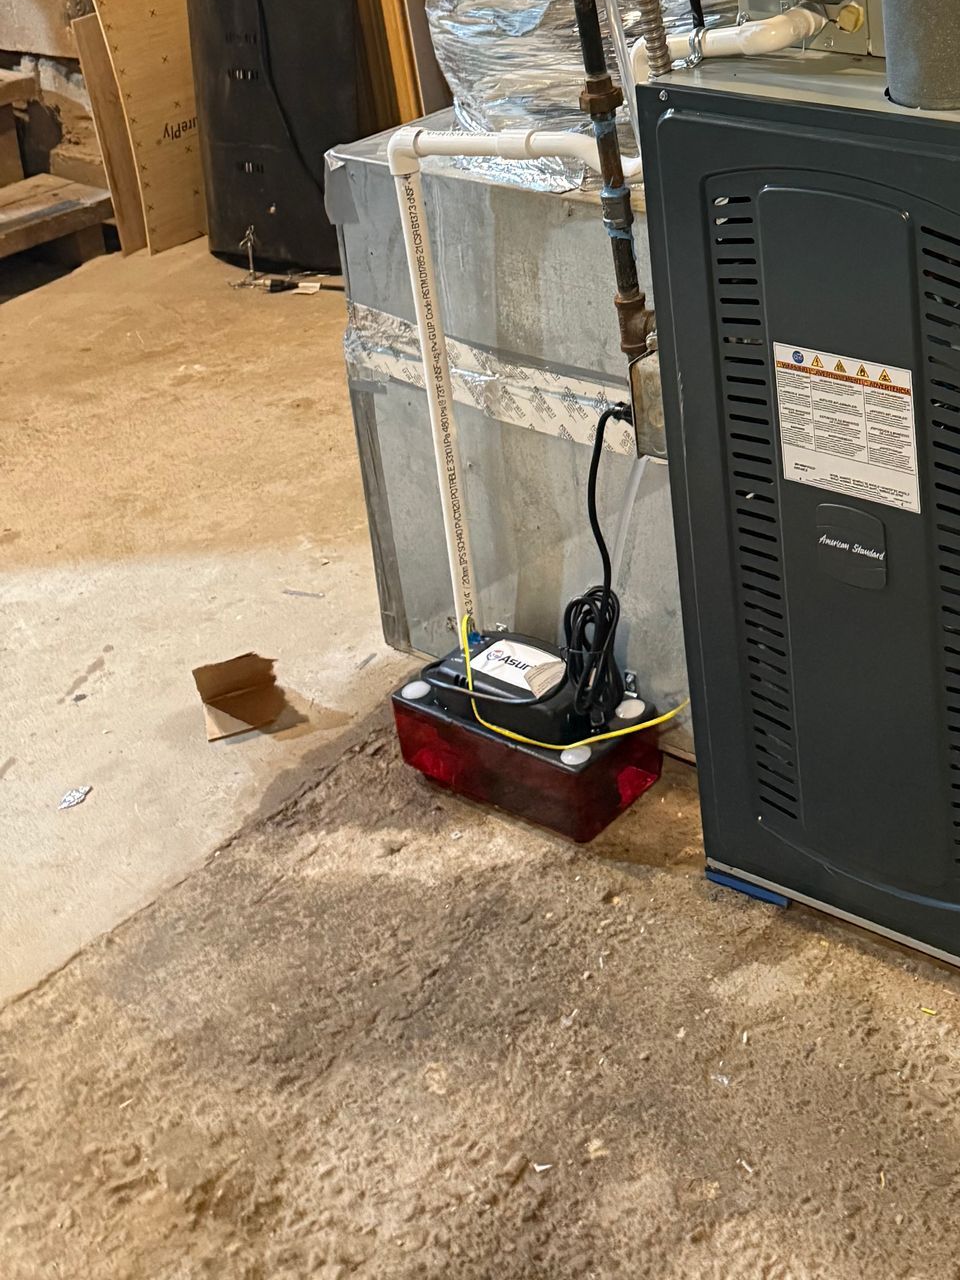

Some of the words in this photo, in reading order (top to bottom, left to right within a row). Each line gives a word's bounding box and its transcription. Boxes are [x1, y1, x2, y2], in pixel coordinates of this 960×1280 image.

[440, 416, 450, 432] 480
[818, 533, 850, 550] American
[852, 543, 886, 561] Standard
